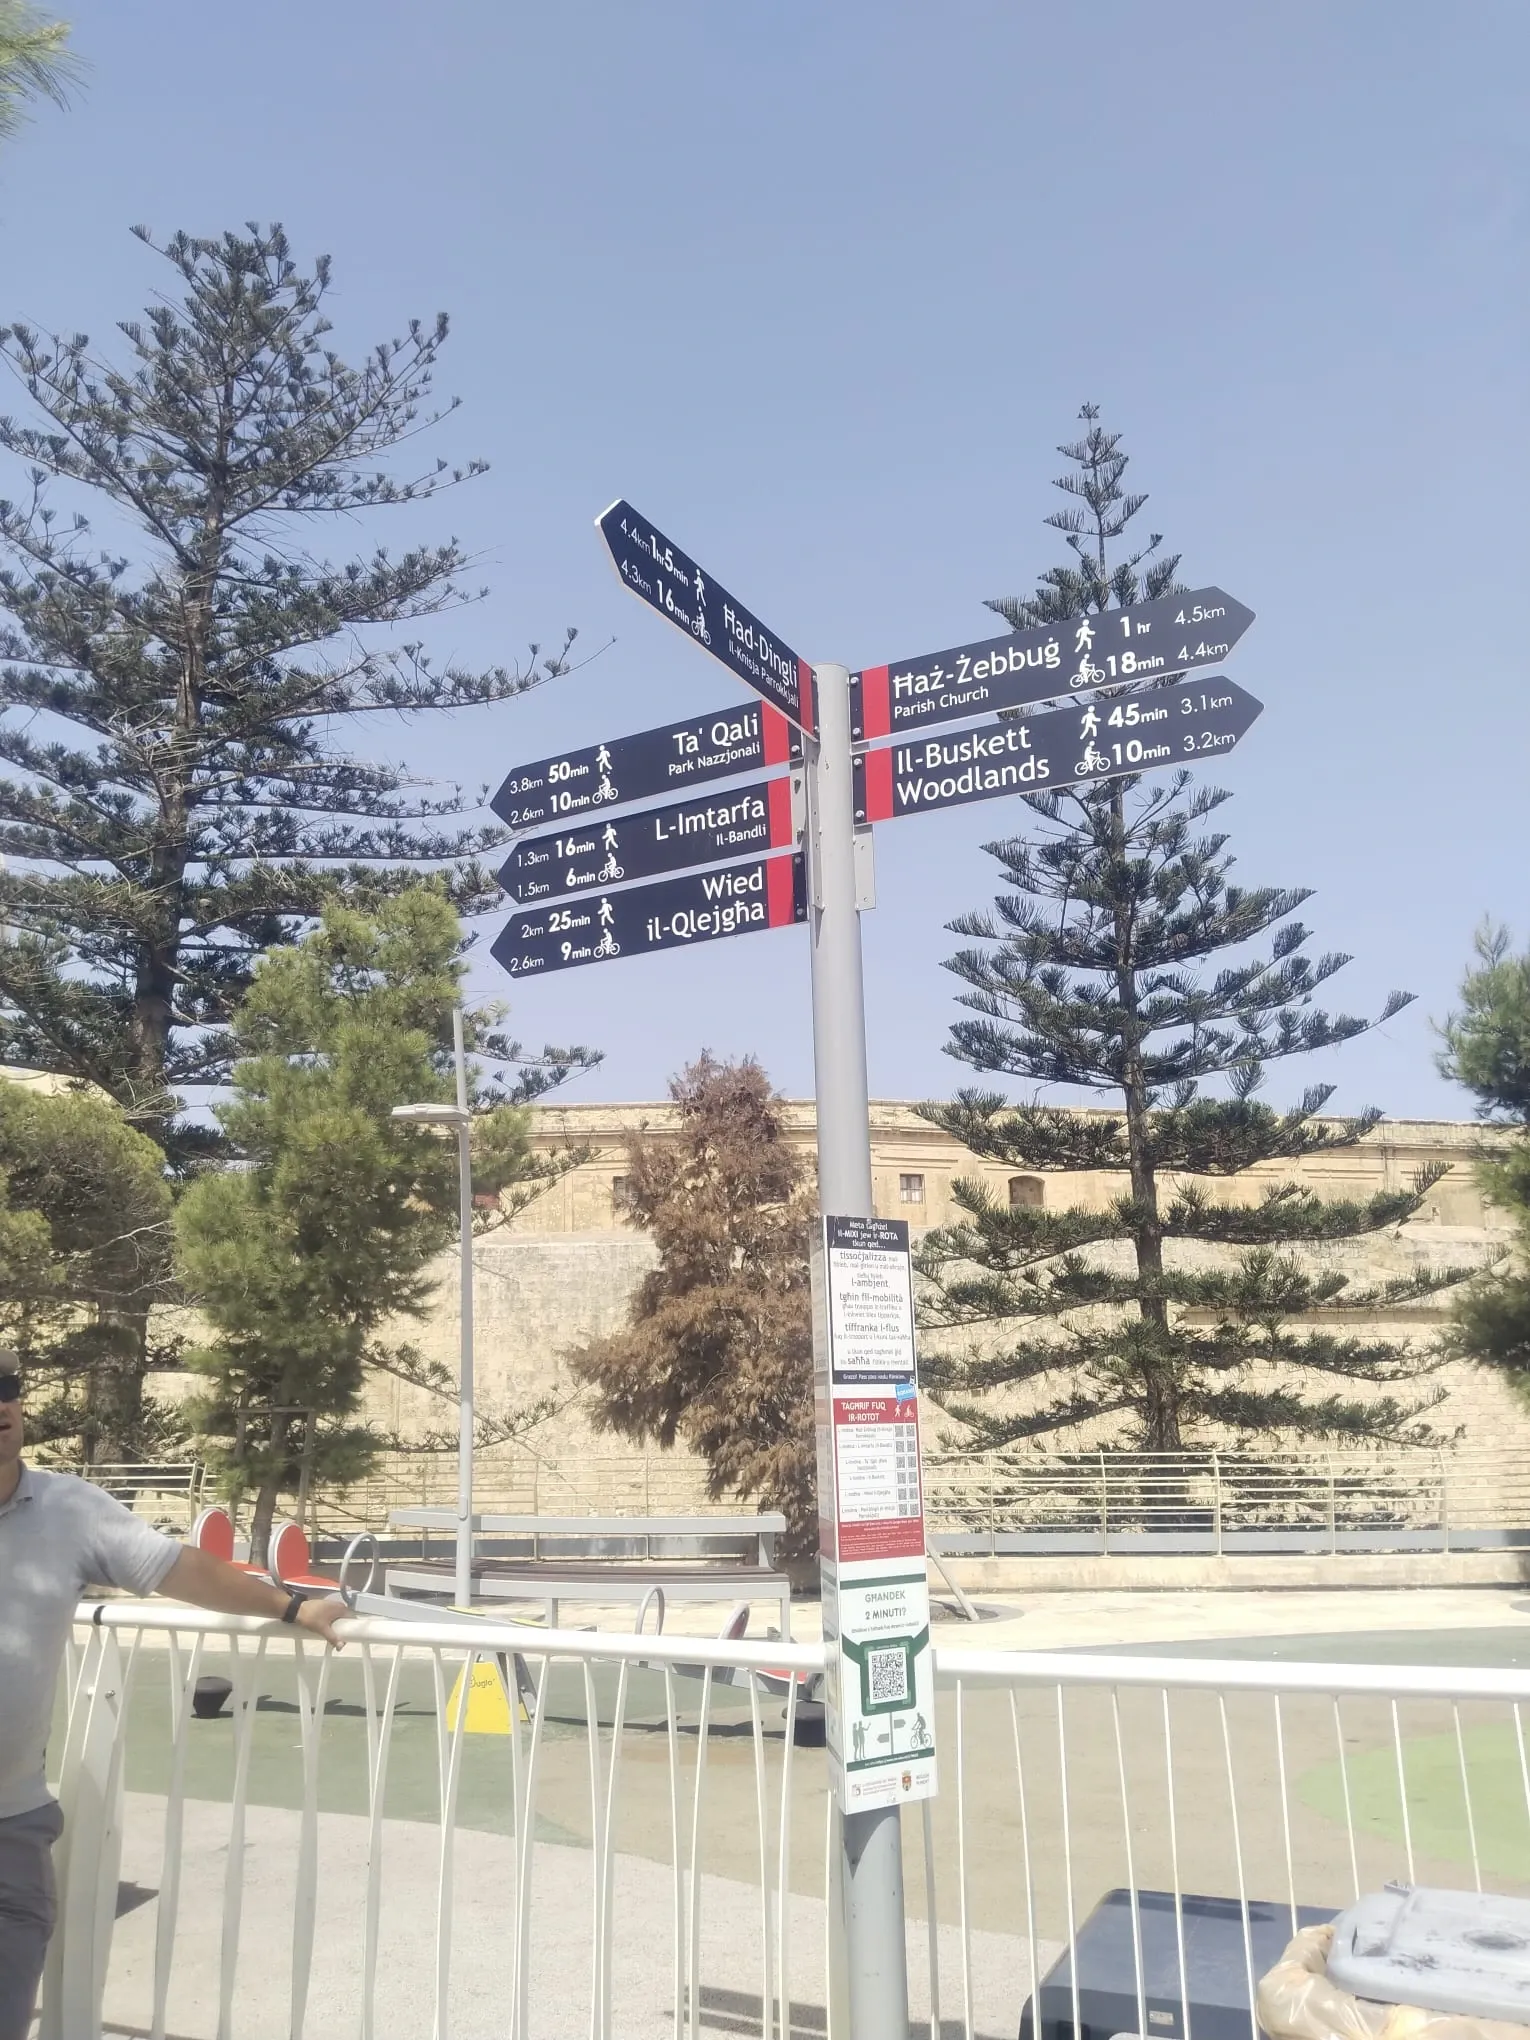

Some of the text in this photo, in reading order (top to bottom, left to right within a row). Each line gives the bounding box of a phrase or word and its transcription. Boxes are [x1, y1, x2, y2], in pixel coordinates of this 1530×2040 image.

[620, 518, 651, 554] 4.4km
[621, 559, 690, 624] 4.3km 16min
[1174, 605, 1226, 625] 4.5km
[723, 603, 798, 689] Ħad-Dingli
[728, 639, 760, 676] Il-Knisja
[1106, 641, 1230, 677] 18min 4.4km
[893, 637, 1060, 699] Ħaż-Żebbuġ
[894, 686, 989, 719] Parish Church
[1107, 694, 1233, 729] 45min 3.1km
[673, 713, 759, 756] Ta' Qali
[897, 725, 1032, 775] Il-Buskett
[1111, 731, 1236, 766] 10min 3.2km
[668, 742, 761, 777] Park Nazzjonali
[510, 761, 589, 795] 3.8km 50min
[897, 755, 1050, 807] Woodlands
[511, 791, 590, 825] 2.6km 10min
[655, 797, 766, 842] L-Imtarfa
[517, 837, 595, 868] 1.3km 16min
[517, 868, 596, 898] 1.5km 6min
[702, 866, 763, 901] Wied
[521, 910, 590, 940] 2km 25min
[646, 901, 766, 942] il-Qlejgħa
[510, 941, 591, 973] 2.6km 9min
[848, 1413, 880, 1422] IR-ROTOT
[871, 1401, 886, 1411] FUQ
[865, 1607, 907, 1620] 2 MINUTI?
